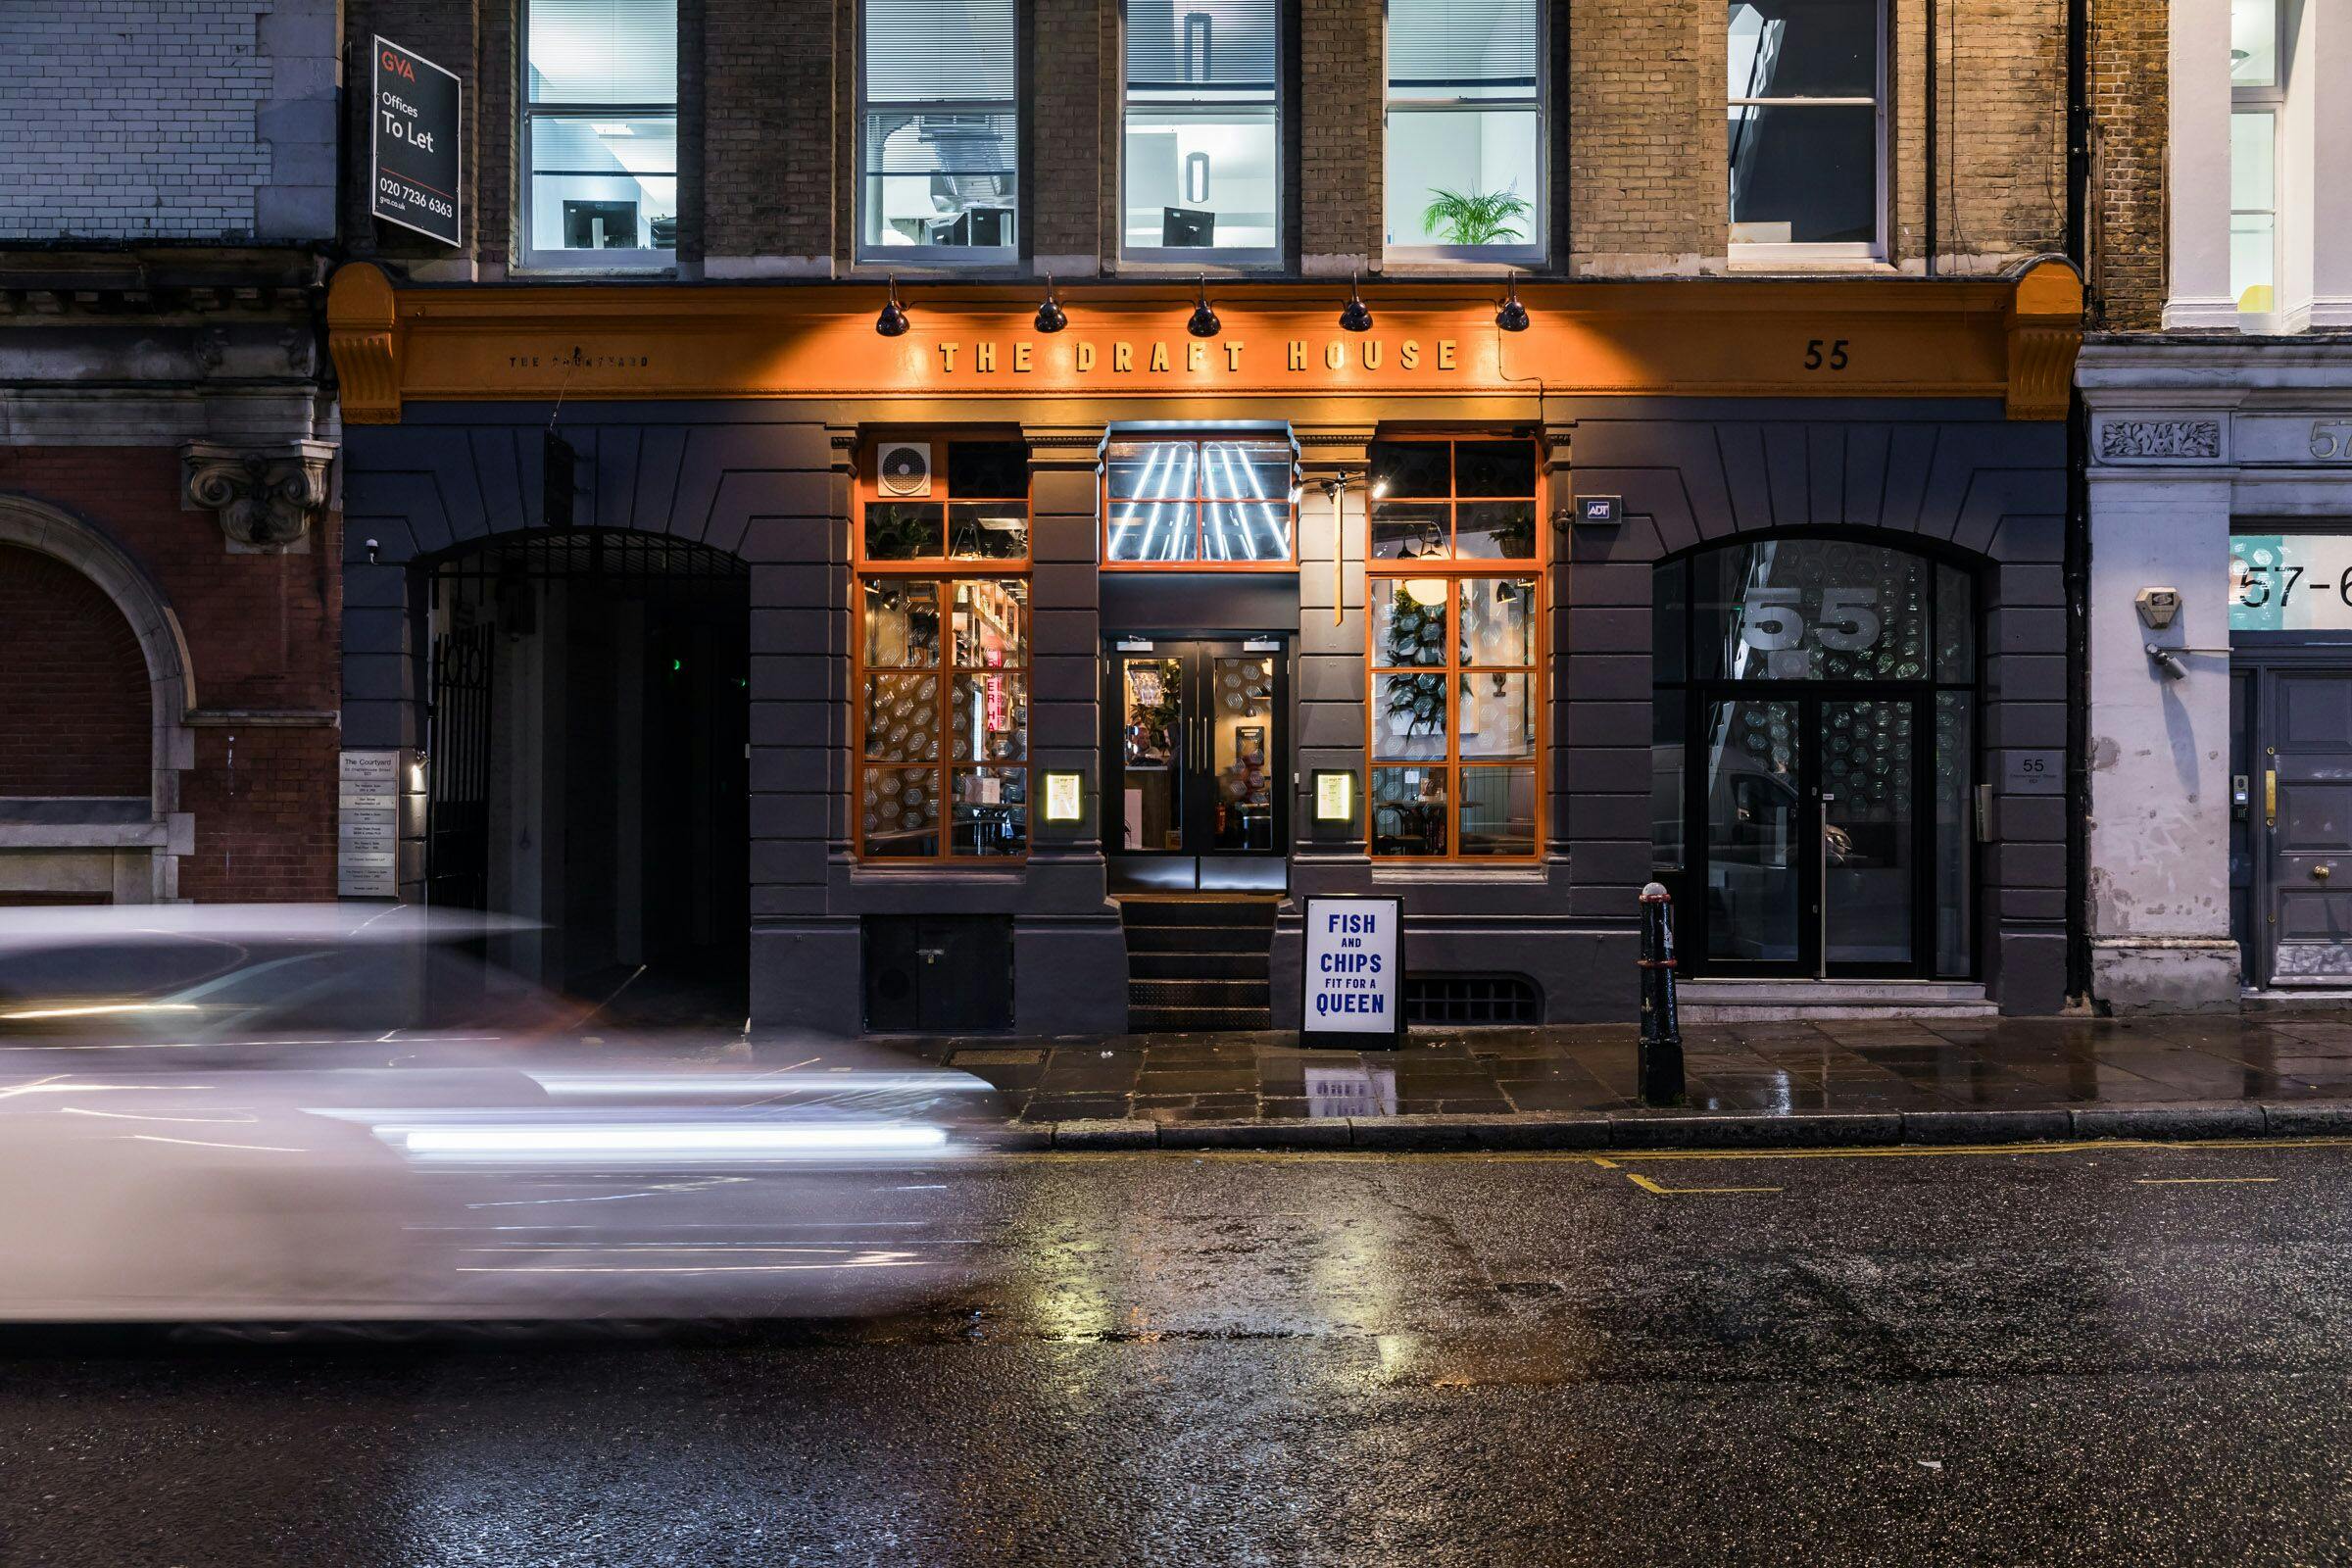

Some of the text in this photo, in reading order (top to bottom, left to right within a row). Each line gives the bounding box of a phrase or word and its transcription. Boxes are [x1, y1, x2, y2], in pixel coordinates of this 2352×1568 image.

[381, 50, 416, 84] GVA
[382, 91, 418, 118] Offices
[381, 110, 434, 153] To Let
[379, 196, 406, 211] gva.co.uk
[380, 177, 453, 219] 020 7236 6363
[509, 357, 539, 368] THE
[939, 339, 1457, 372] THE DRAFT HOUSE
[1804, 339, 1849, 370] 55
[1589, 505, 1609, 515] ADT
[1740, 588, 1881, 651] 55
[2023, 759, 2044, 772] 55
[1328, 914, 1376, 934] FISH
[1342, 938, 1361, 948] AND
[1320, 954, 1382, 973] CHIPS
[1325, 978, 1376, 989] FIT FOR A
[1316, 993, 1384, 1016] QUEEN
